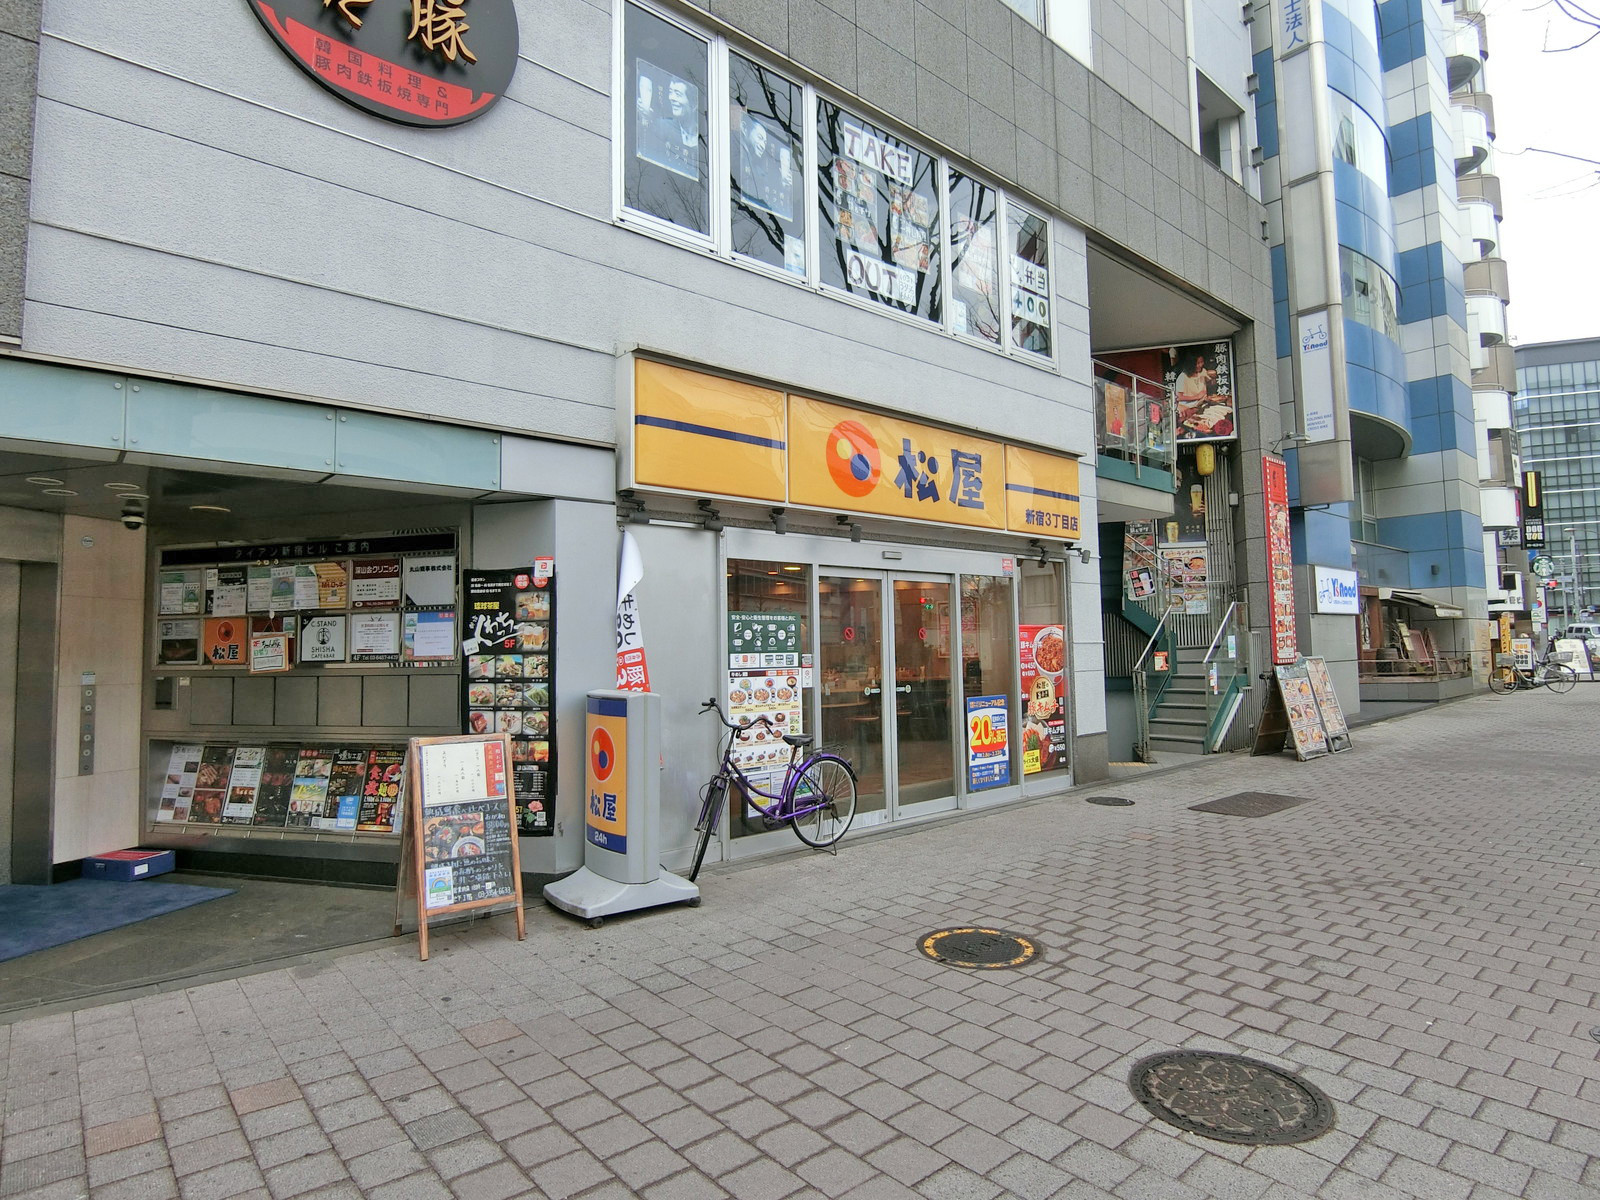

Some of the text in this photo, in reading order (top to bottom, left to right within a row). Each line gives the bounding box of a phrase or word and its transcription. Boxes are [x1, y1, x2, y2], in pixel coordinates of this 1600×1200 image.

[314, 37, 449, 98] 韓国料理&
[314, 54, 449, 117] 豚肉鉄板焼専門
[844, 125, 911, 183] TAKE
[847, 255, 897, 297] OUT
[1214, 343, 1230, 396] 豚肉鉄板焼
[893, 438, 985, 510] 松屋
[1025, 508, 1079, 532] 新宿3丁目店
[621, 594, 637, 645] 牛めし
[212, 644, 239, 660] 松屋
[504, 640, 516, 649] 5F
[1027, 700, 1058, 716] 豚キムチ
[589, 788, 617, 822] 松屋
[594, 830, 608, 845] 24h
